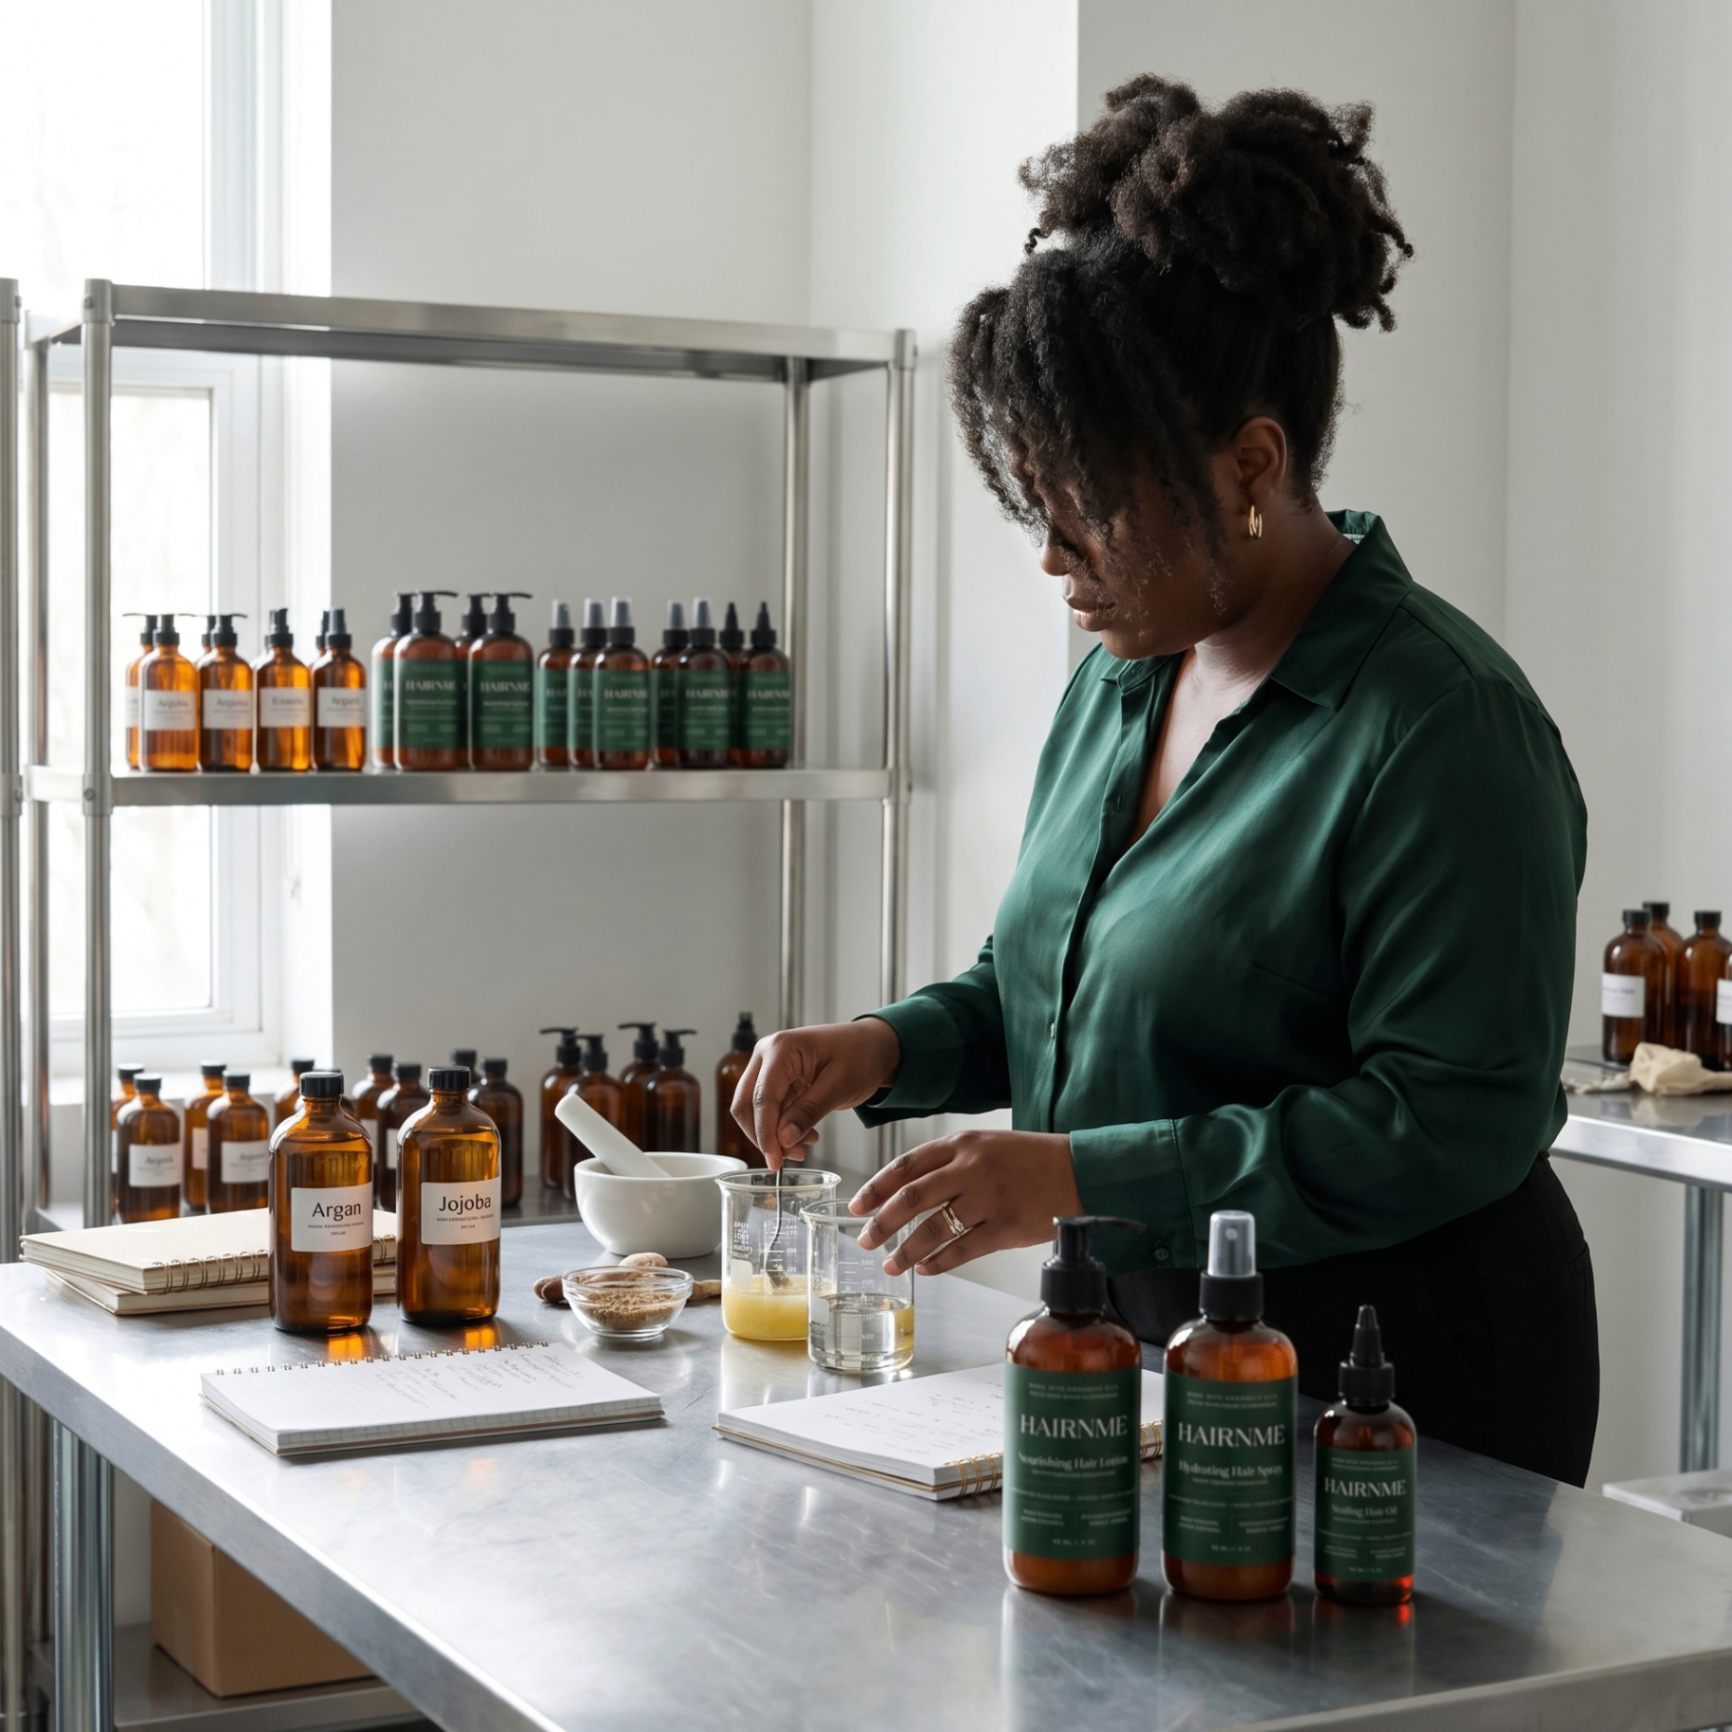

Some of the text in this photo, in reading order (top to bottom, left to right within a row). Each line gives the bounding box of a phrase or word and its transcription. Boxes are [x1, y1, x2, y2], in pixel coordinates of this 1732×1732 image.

[311, 1202, 362, 1221] Argan
[438, 1193, 492, 1215] Jojoba
[1020, 1413, 1128, 1439] HAIRNME
[1178, 1422, 1286, 1448] HAIRNME
[1074, 1457, 1099, 1469] Hair
[1178, 1459, 1230, 1479] Hydrating
[1231, 1465, 1256, 1477] Hair
[1324, 1476, 1407, 1498] HAIRNME
